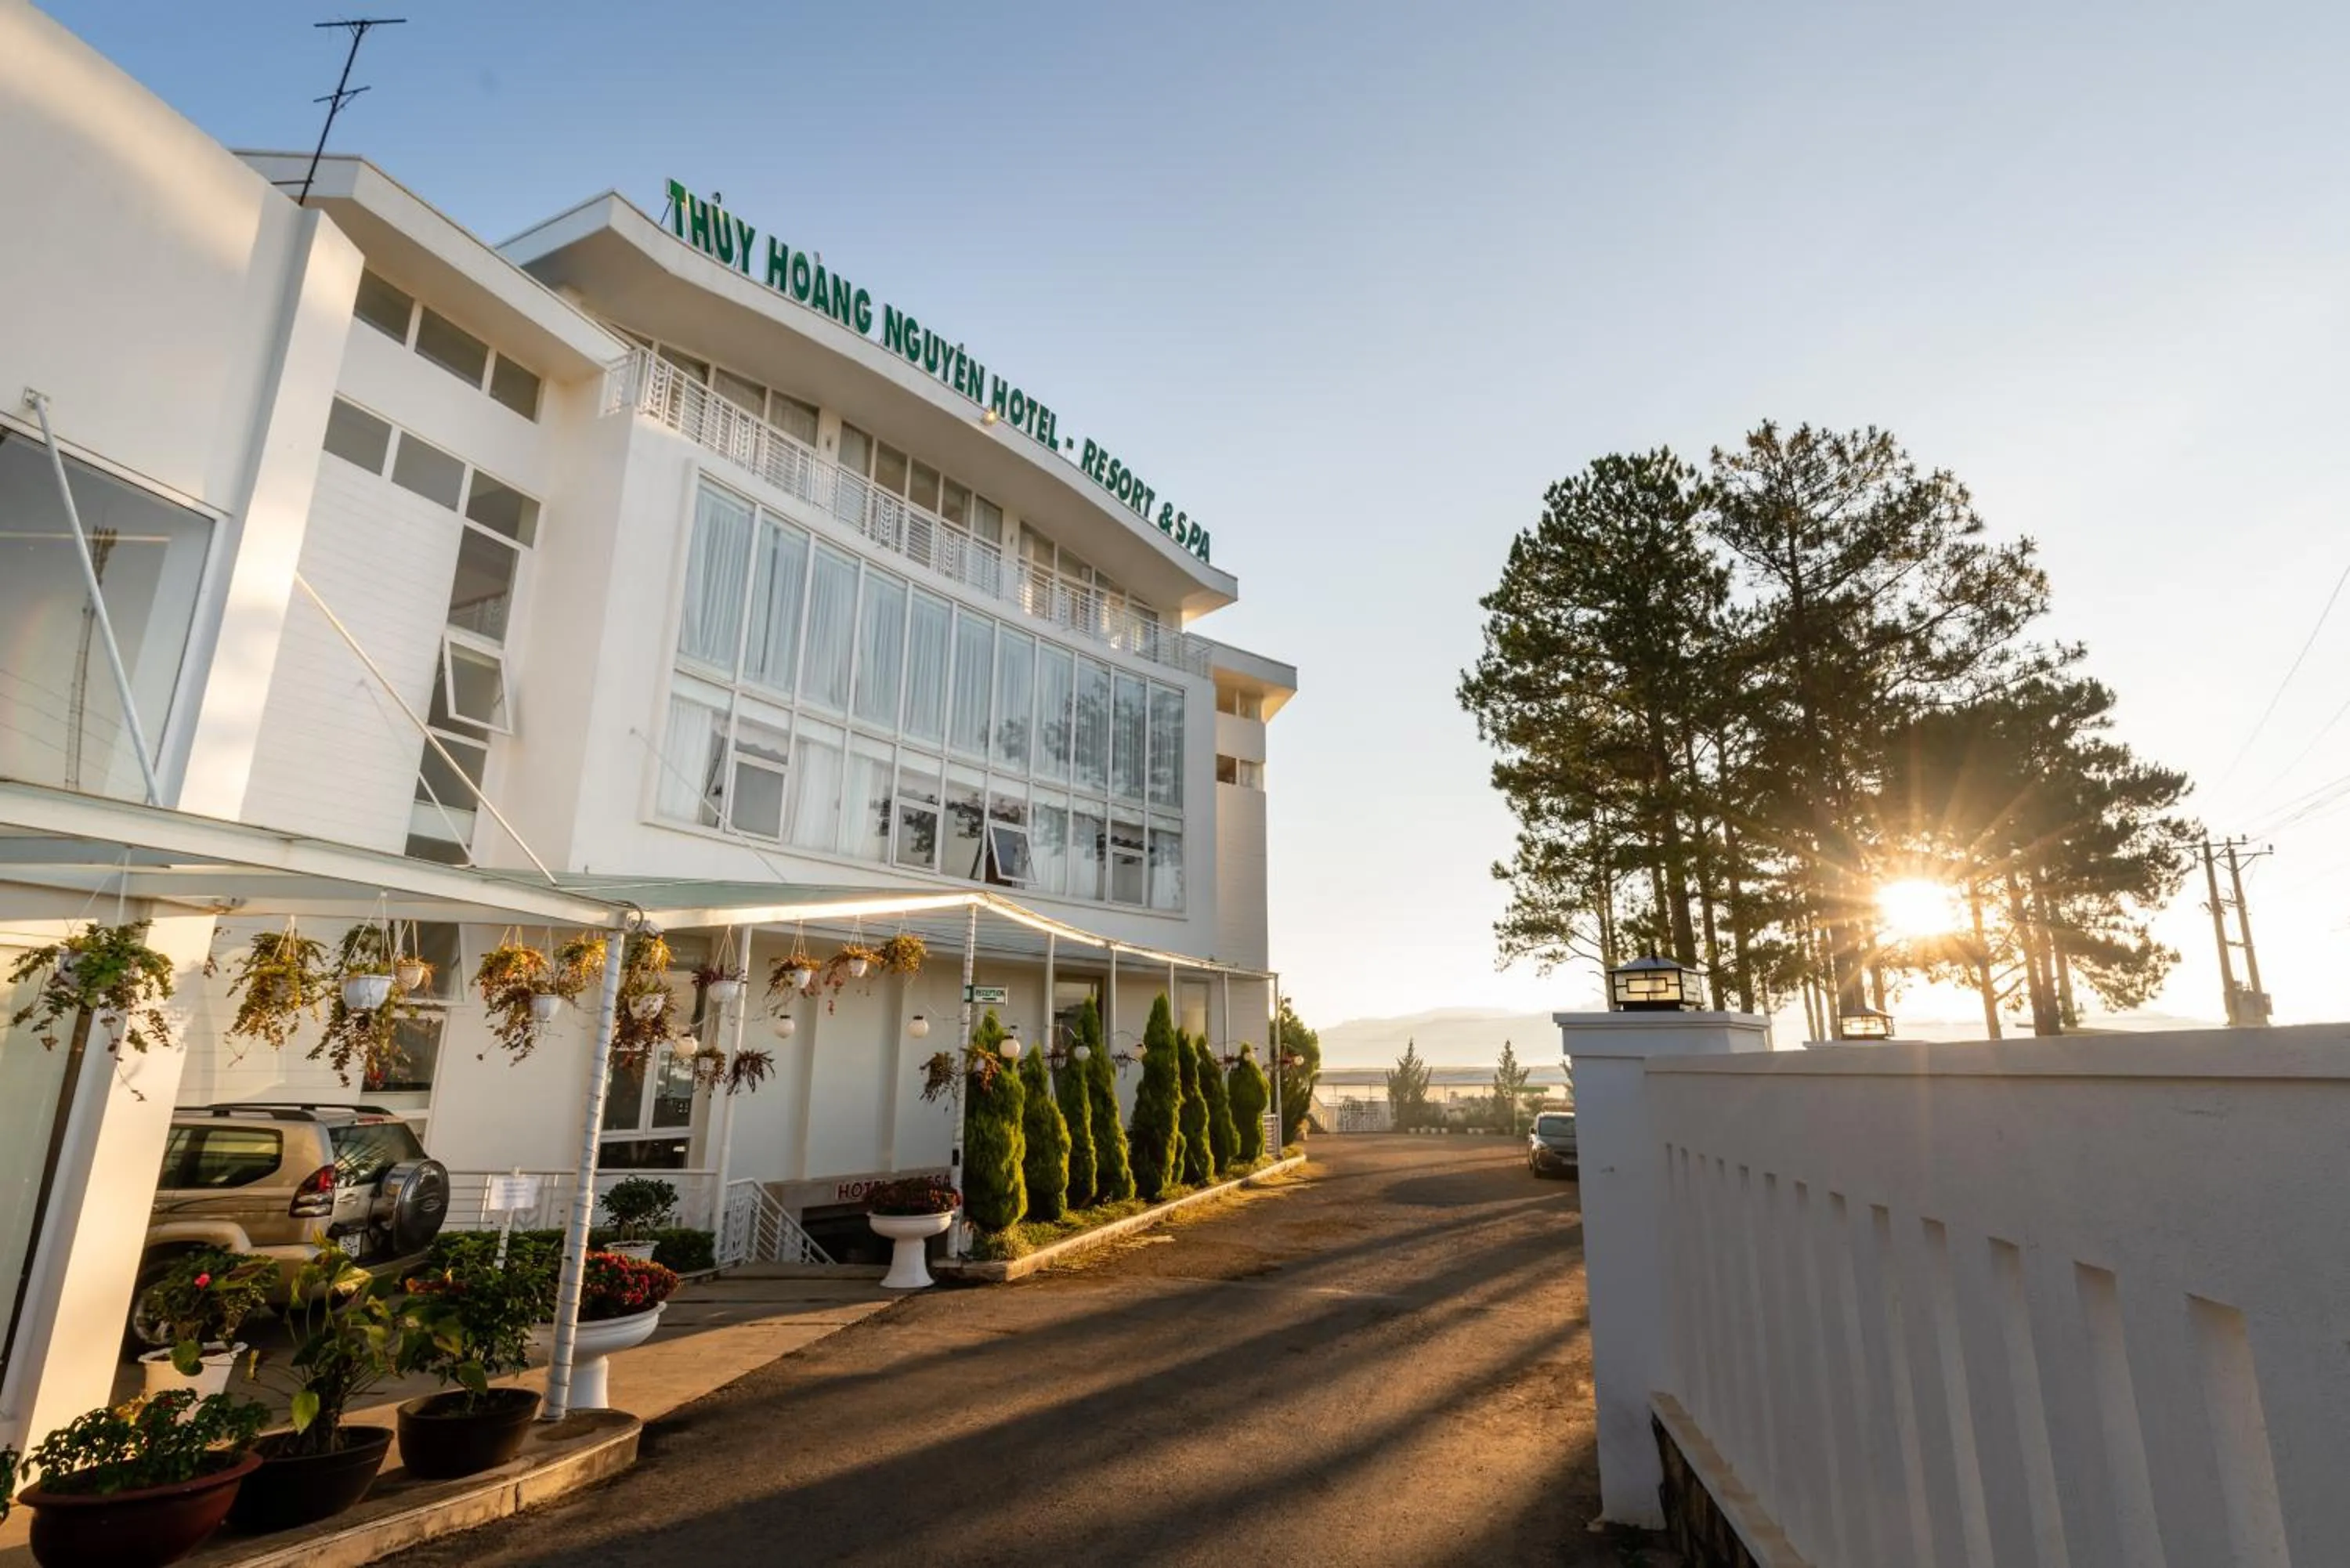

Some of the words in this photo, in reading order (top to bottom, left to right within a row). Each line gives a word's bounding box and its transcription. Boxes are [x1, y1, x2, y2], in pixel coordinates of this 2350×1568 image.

[667, 178, 755, 274] THỦY
[765, 235, 873, 334] HOÀNG
[991, 374, 1058, 451] HOTEL
[1081, 438, 1155, 518] RESORT
[1158, 502, 1173, 532] &
[1177, 511, 1209, 563] SPA
